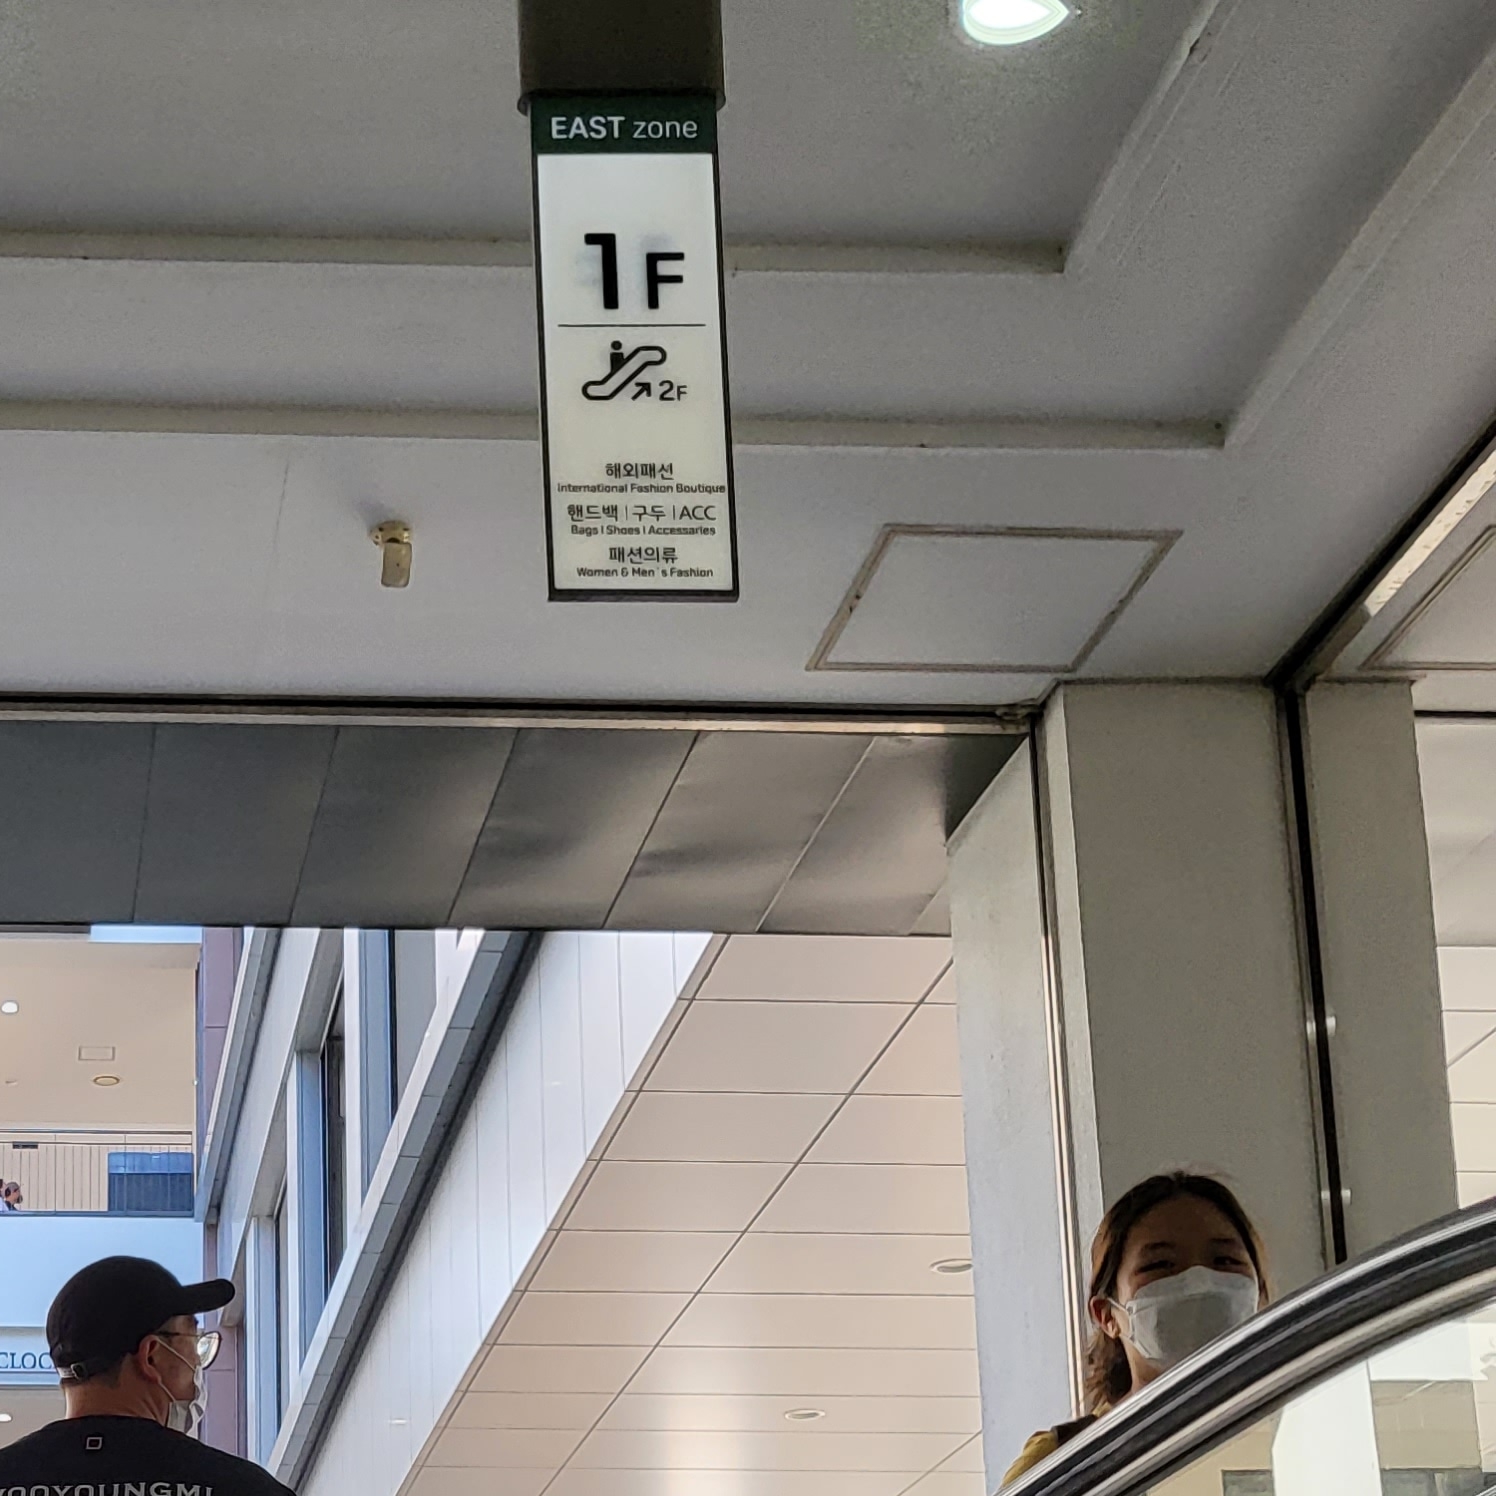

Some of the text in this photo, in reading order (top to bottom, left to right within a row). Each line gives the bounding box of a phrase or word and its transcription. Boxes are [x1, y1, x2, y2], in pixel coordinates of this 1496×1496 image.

[550, 116, 698, 139] EAST zone
[584, 233, 685, 309] 1F
[658, 380, 688, 401] 2F
[557, 483, 726, 495] International Fashion Boutique
[567, 504, 717, 522] 핸드백 구두 ACC
[571, 525, 599, 537] Bags
[606, 525, 640, 535] Shoes
[609, 546, 678, 564] 패션의류
[577, 567, 618, 577] Women
[670, 567, 714, 577] Fashion
